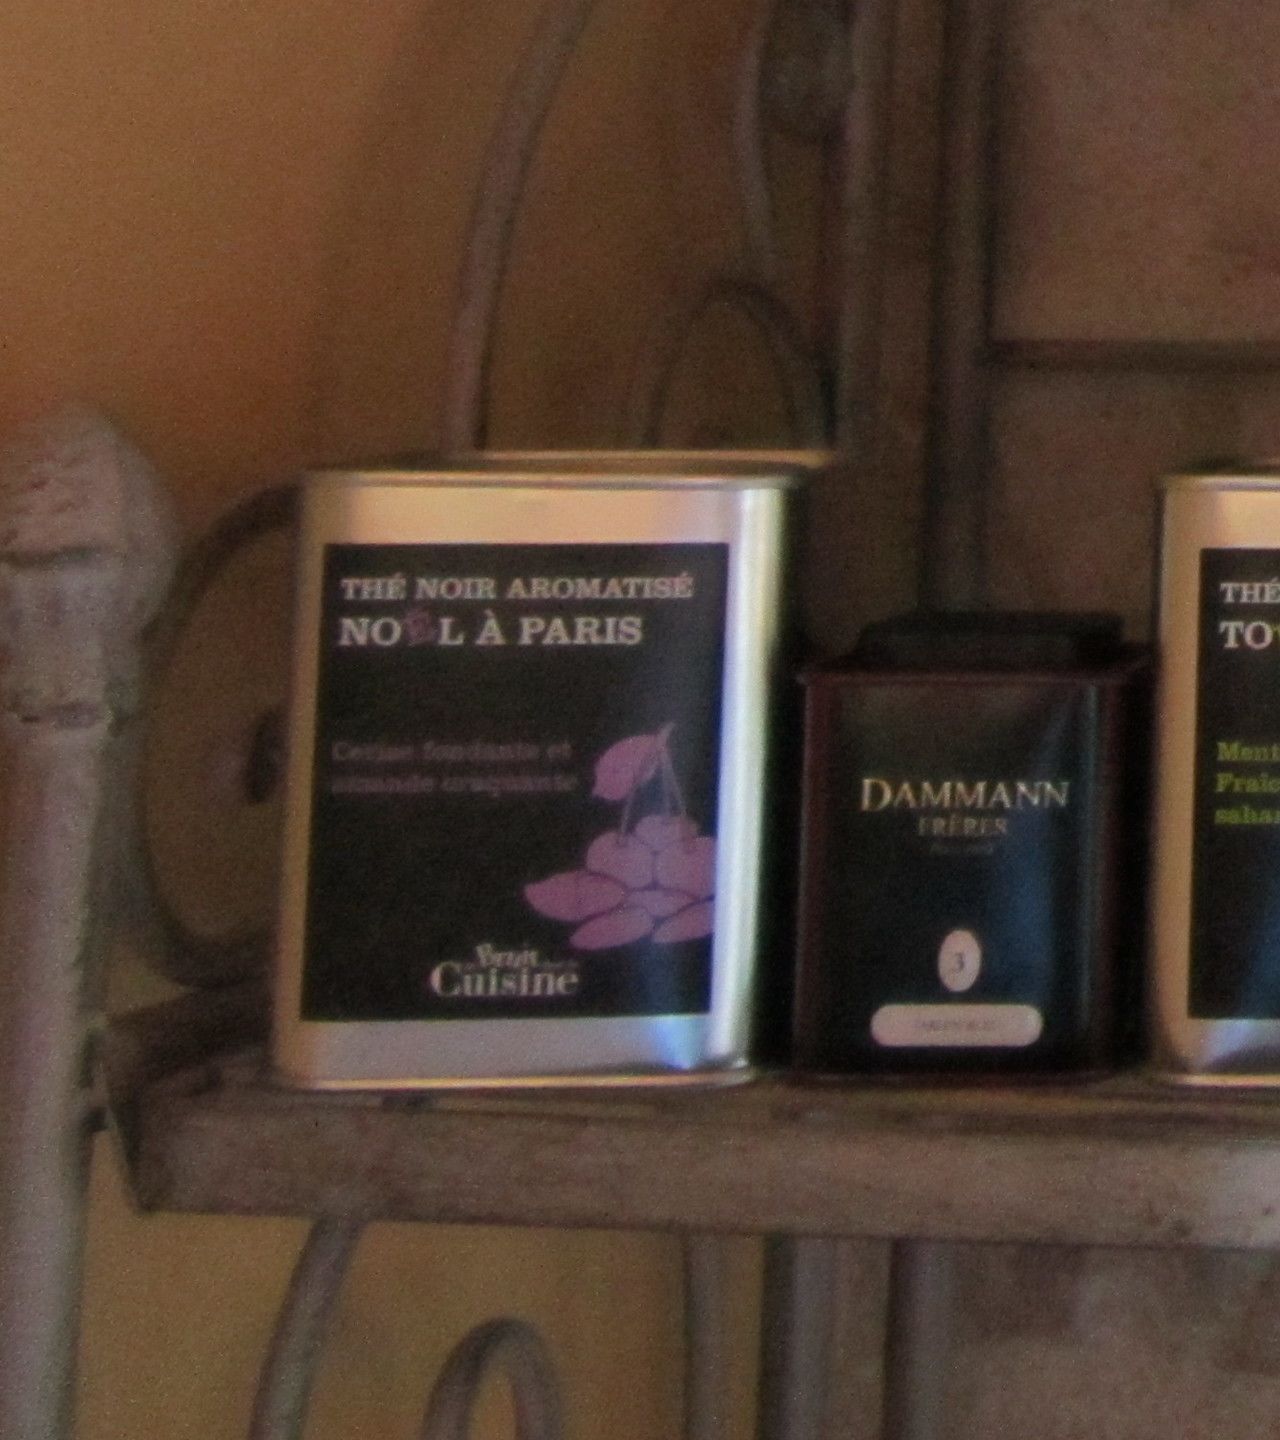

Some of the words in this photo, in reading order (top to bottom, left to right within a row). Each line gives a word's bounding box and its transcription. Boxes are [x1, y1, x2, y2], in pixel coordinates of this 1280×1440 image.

[341, 572, 407, 601] THÉ
[413, 578, 498, 601] NOIR
[504, 571, 694, 600] AROMATISÉ
[476, 609, 507, 646] À
[517, 616, 644, 647] PARIS
[546, 741, 574, 761] et
[861, 778, 1070, 812] DAMMANN
[430, 962, 579, 997] Cuisine
